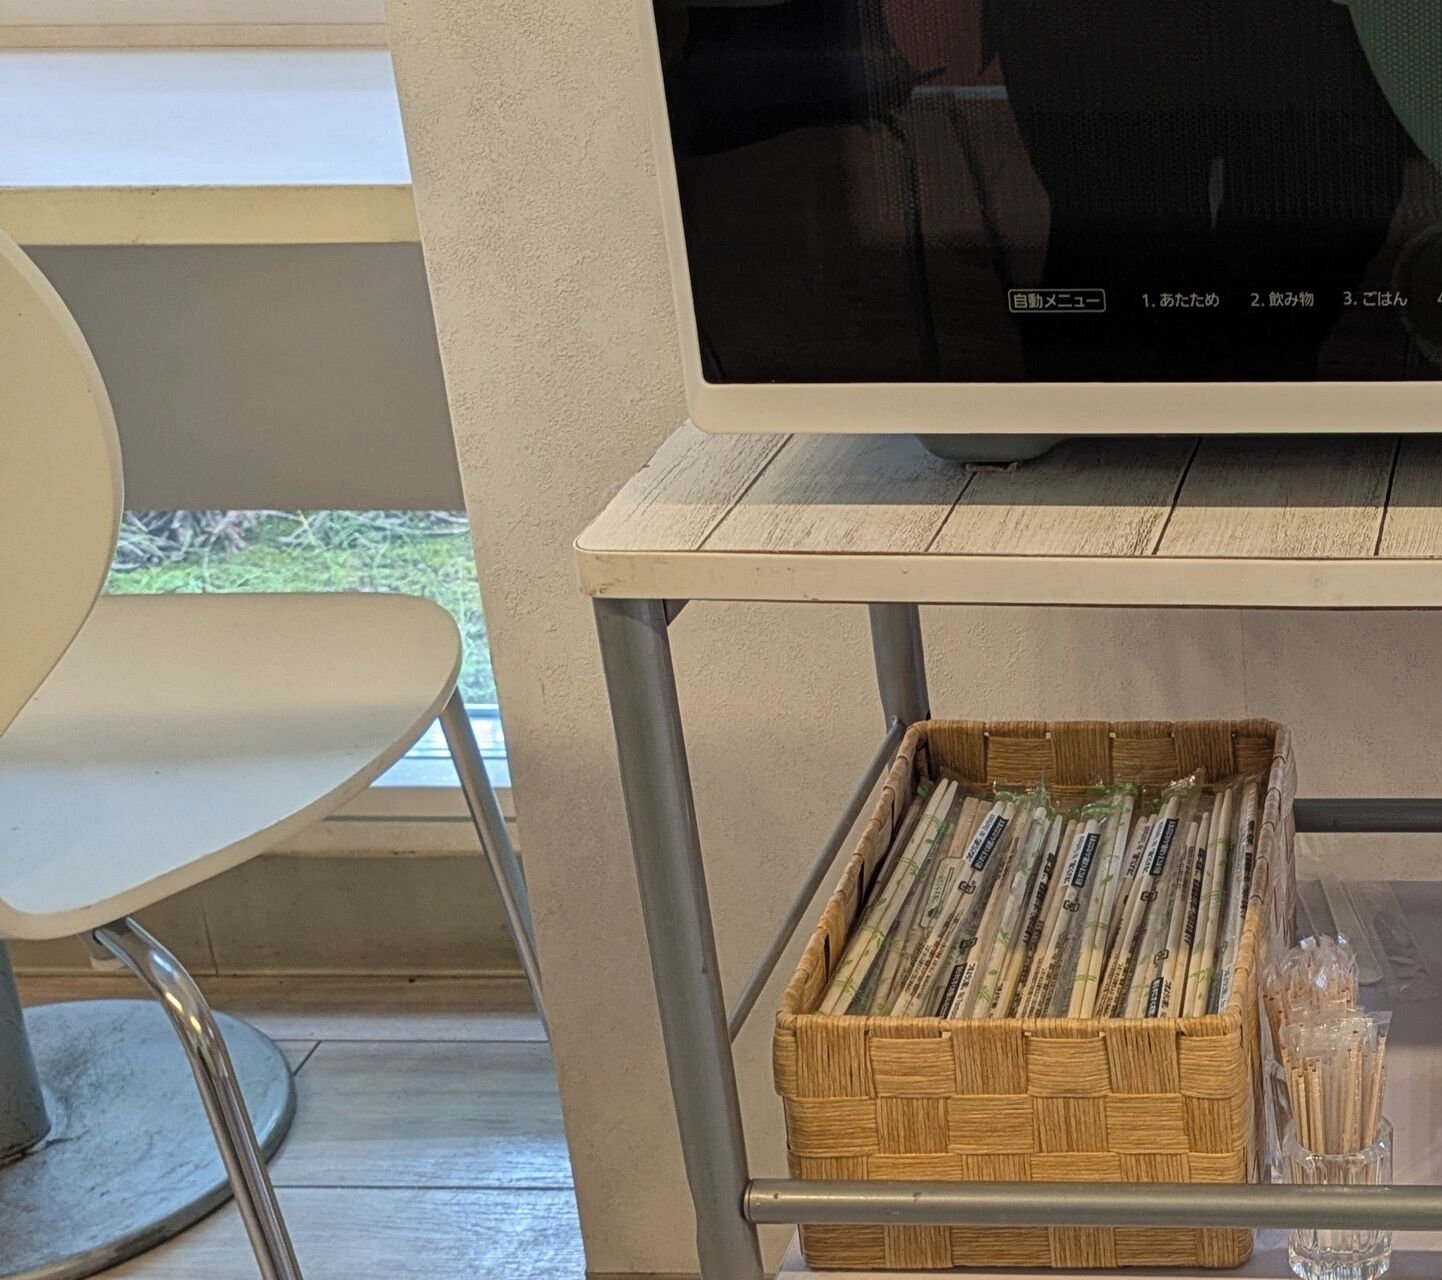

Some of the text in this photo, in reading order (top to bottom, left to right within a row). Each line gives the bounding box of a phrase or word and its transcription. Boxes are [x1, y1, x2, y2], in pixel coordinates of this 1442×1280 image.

[1013, 293, 1100, 309] 自動メニュー
